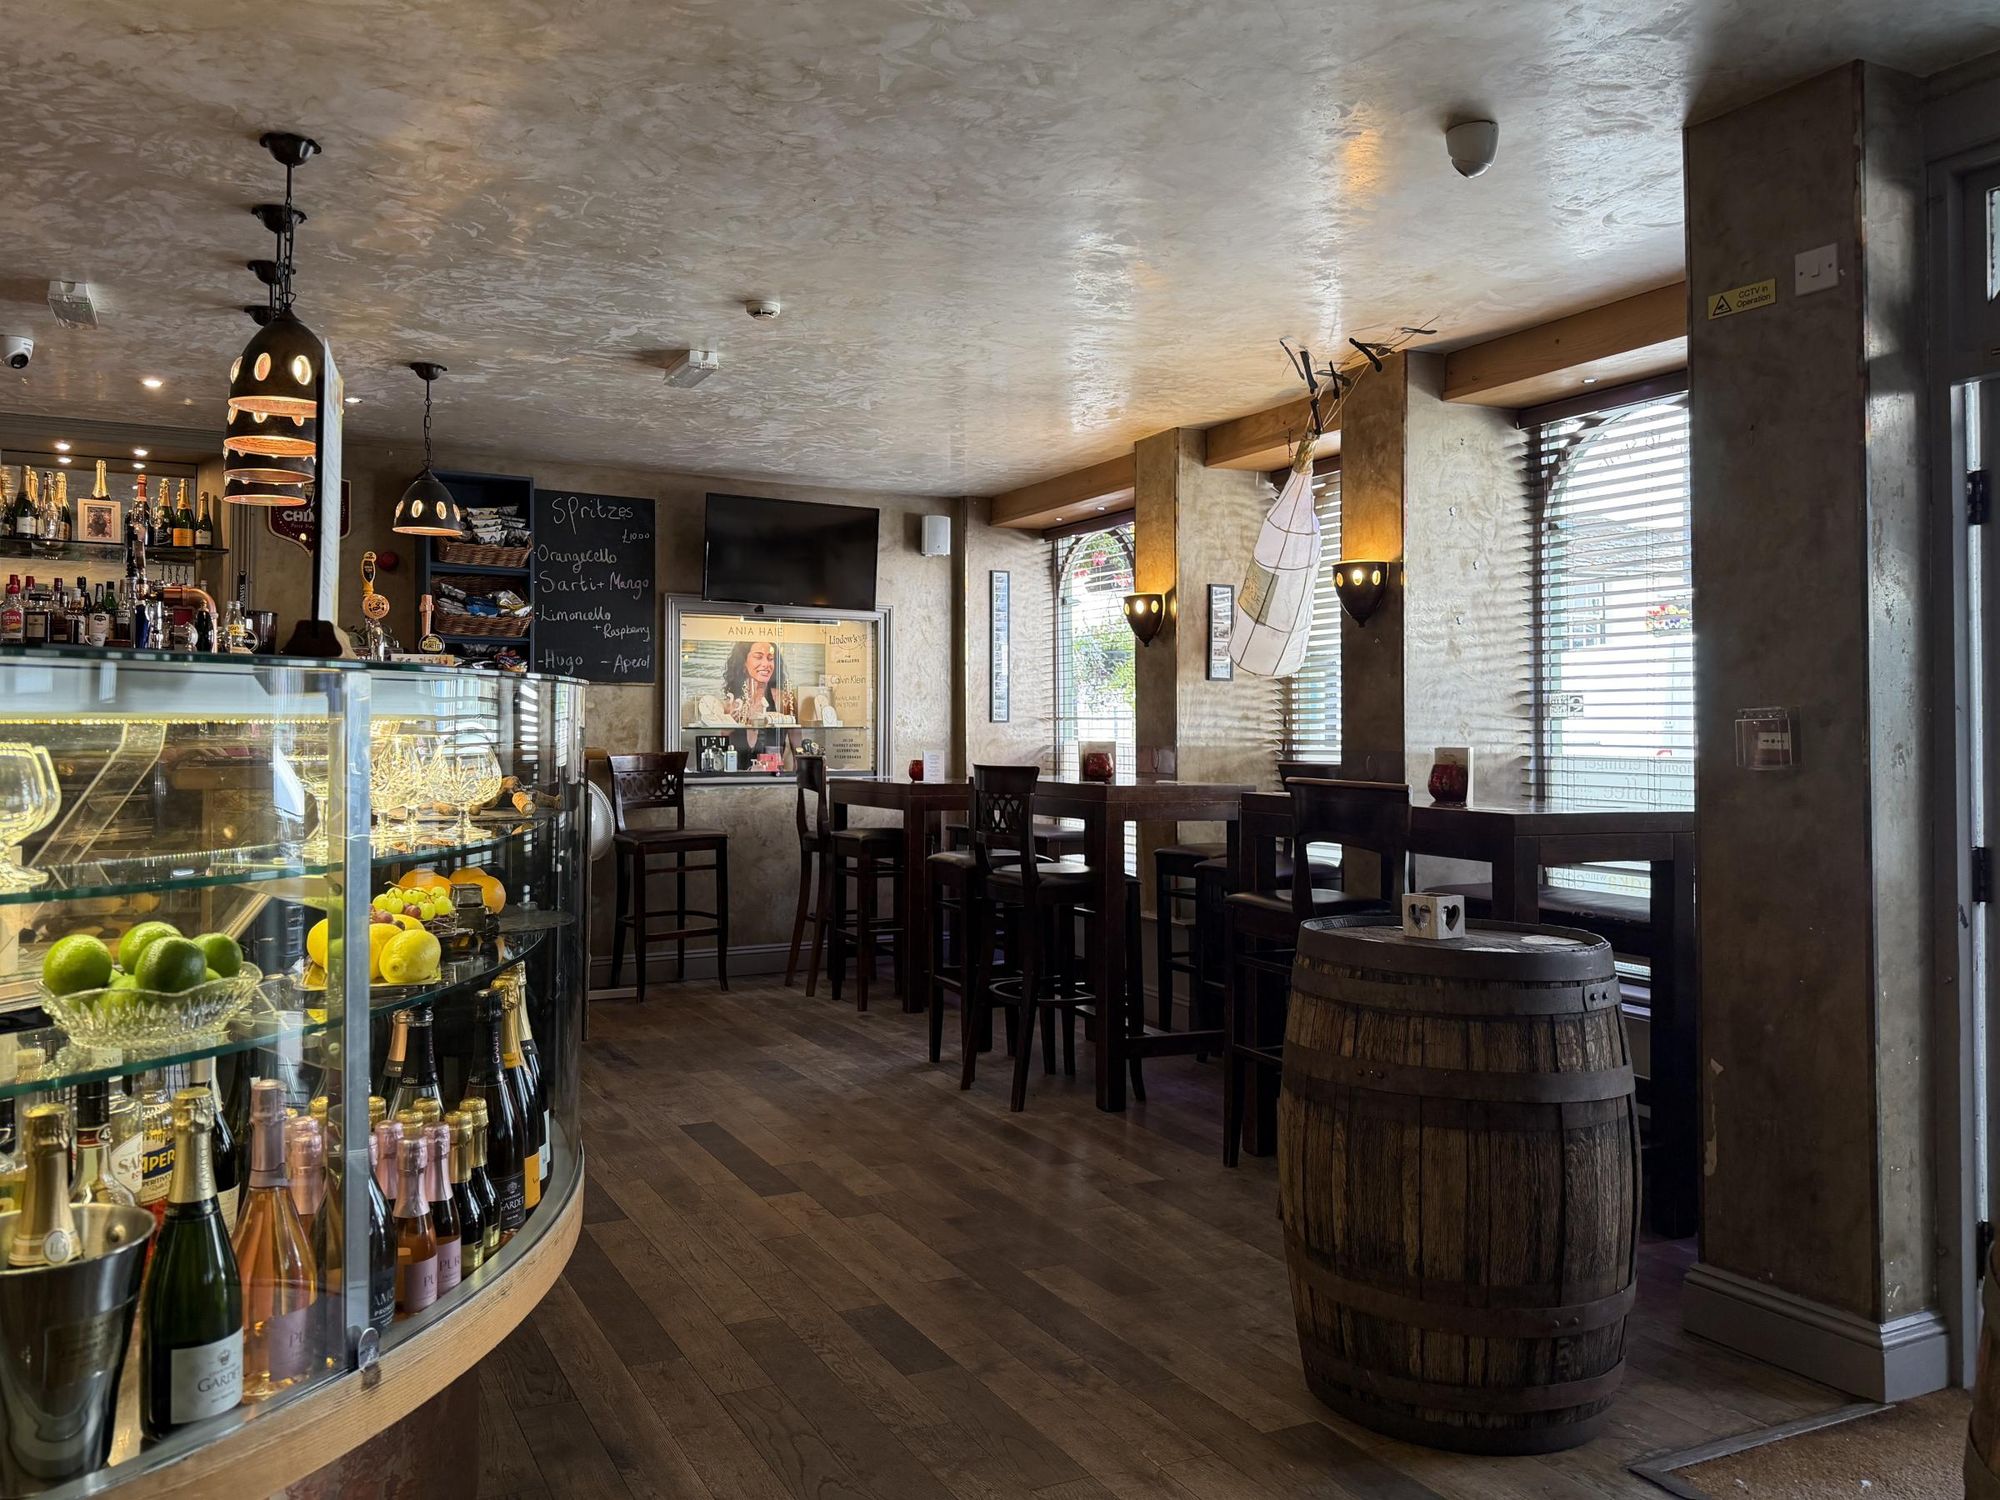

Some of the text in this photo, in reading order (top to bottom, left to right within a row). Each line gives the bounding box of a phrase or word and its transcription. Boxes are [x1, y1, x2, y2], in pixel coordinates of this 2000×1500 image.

[1737, 293, 1771, 309] Operation
[1738, 285, 1769, 299] CCTV in
[539, 570, 596, 594] Sarti
[609, 571, 649, 600] Mango
[540, 604, 612, 622] Limoncello
[603, 623, 650, 643] Raspberry
[728, 627, 784, 637] ANIA HAIE
[545, 650, 650, 675] Hugo Aperol
[850, 675, 866, 684] Klein
[142, 1149, 176, 1174] APER
